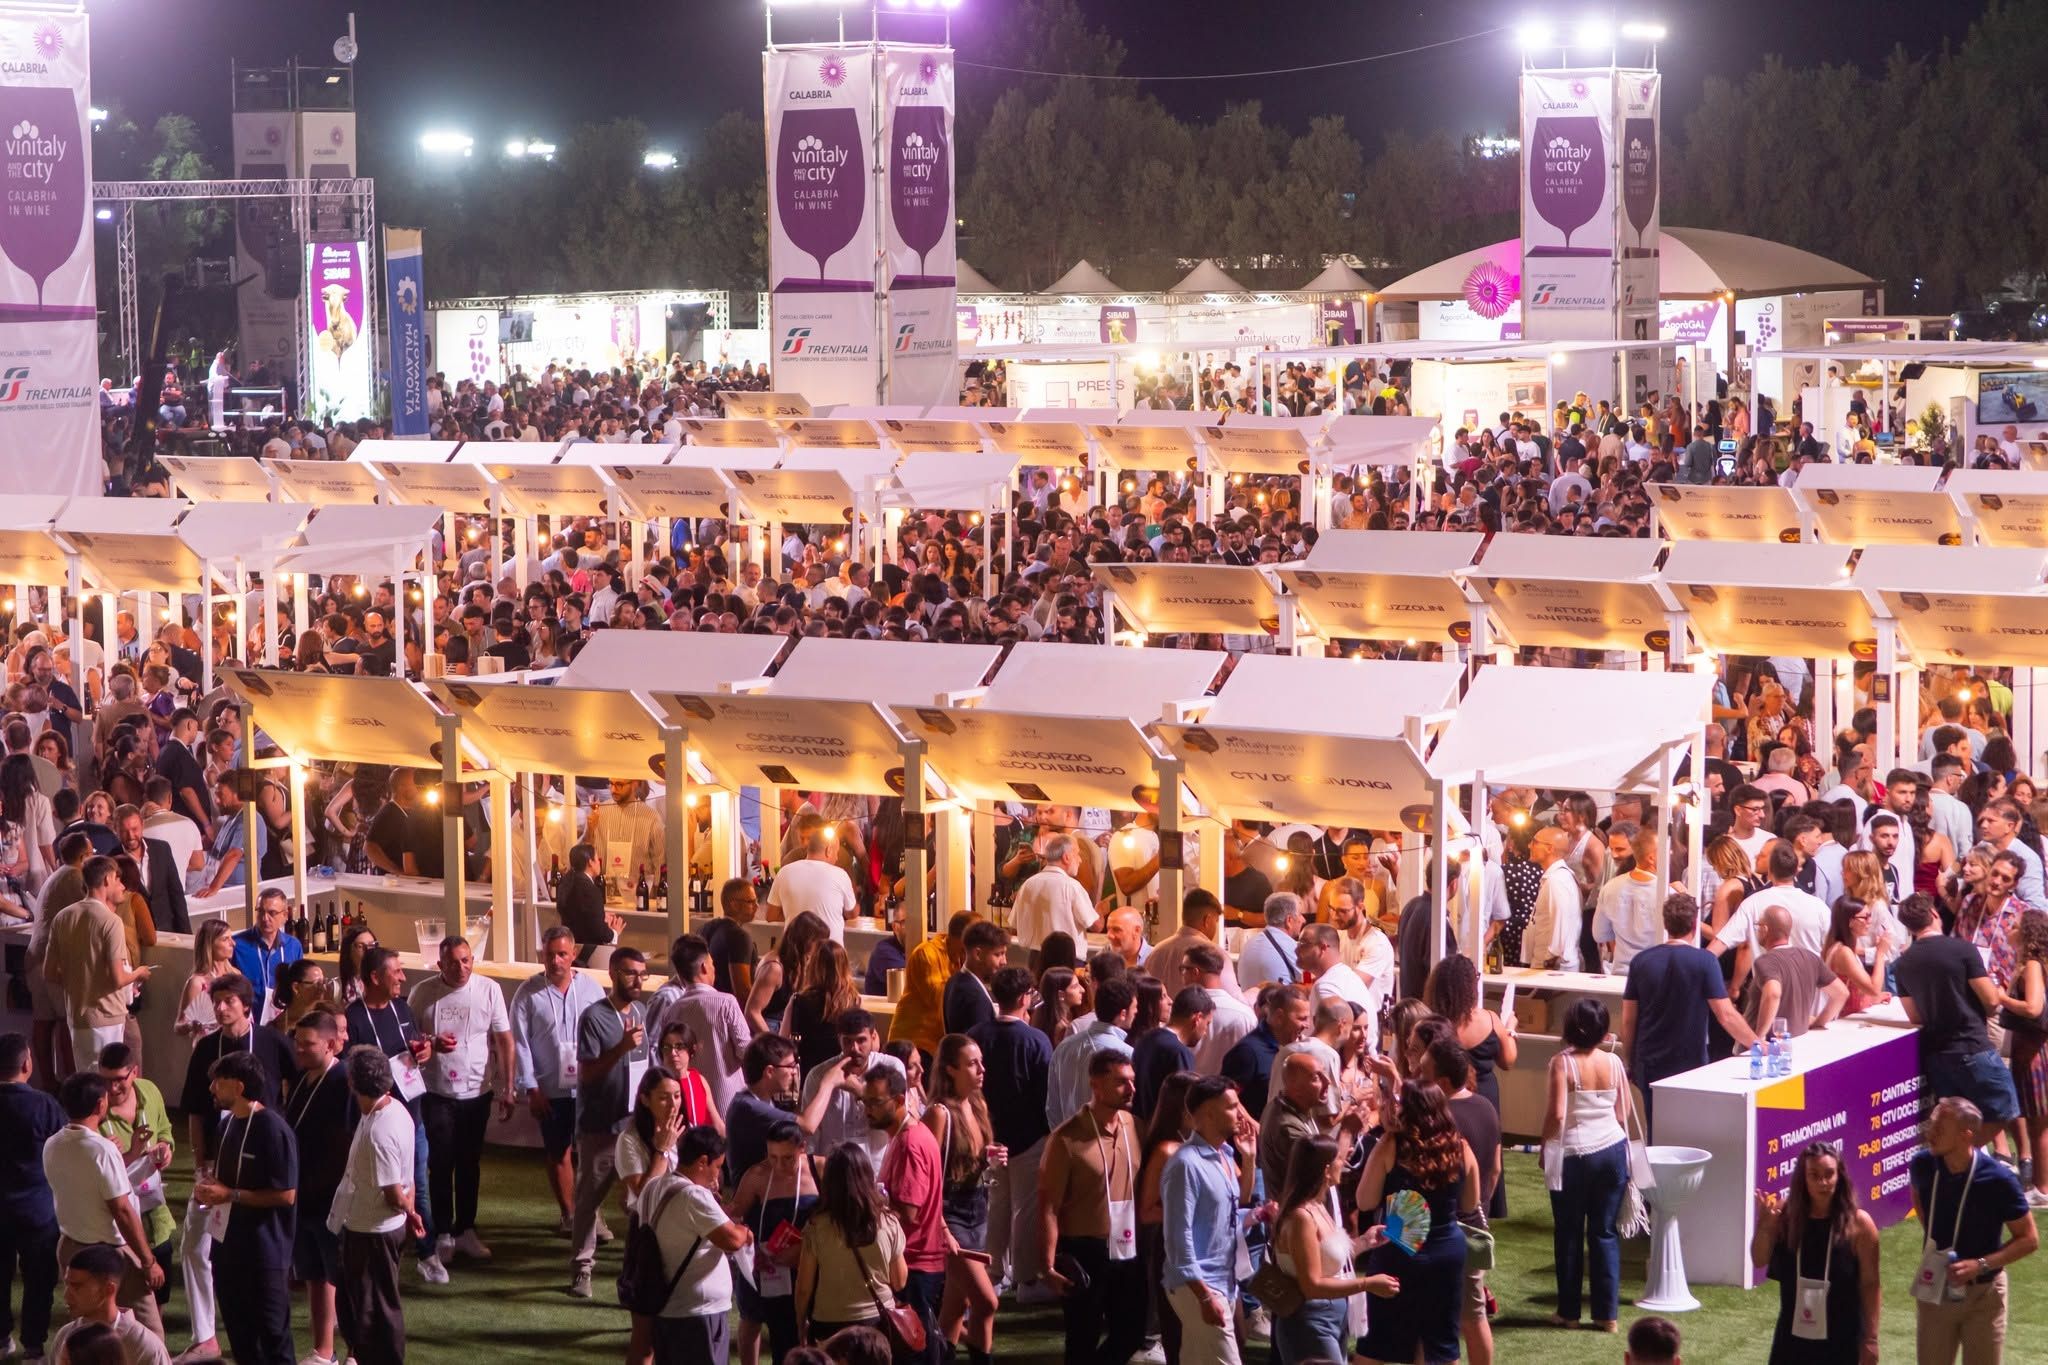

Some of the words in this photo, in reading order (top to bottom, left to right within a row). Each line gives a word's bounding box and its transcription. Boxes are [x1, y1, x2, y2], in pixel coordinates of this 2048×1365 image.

[1, 62, 48, 74] CALABRIA
[790, 90, 832, 100] CALABRIA
[901, 87, 928, 96] CALABRIA
[6, 134, 67, 162] vinitaly
[902, 142, 939, 164] vinitaly
[1545, 145, 1591, 161] vinitaly
[792, 145, 848, 166] vinitaly
[23, 159, 54, 184] city
[807, 165, 836, 184] city
[912, 162, 931, 181] city
[1557, 161, 1580, 175] city
[8, 190, 57, 201] CALABRIA
[794, 189, 839, 199] CALABRIA
[903, 186, 934, 195] CALABRIA
[795, 201, 805, 210] IN
[809, 200, 832, 210] WINE
[913, 198, 930, 206] WINE
[9, 205, 20, 215] IN
[25, 204, 51, 215] WINE
[1553, 297, 1606, 305] TRENITALIA
[1106, 311, 1130, 319] SIBARI
[1324, 310, 1348, 319] SIBARI
[913, 340, 952, 350] TRENITALIA
[1234, 332, 1271, 344] vinitaly
[1282, 334, 1301, 345] city
[807, 345, 868, 354] TRENITALIA
[404, 322, 414, 416] MALAVOLTA
[26, 387, 92, 400] TRENITALIA
[744, 407, 803, 415] CASA
[1526, 613, 1557, 621] SAN
[1786, 619, 1847, 628] GROSSO
[491, 724, 543, 735] TERRE
[747, 732, 844, 746] CONSORZIO
[736, 744, 794, 755] GRECO
[795, 746, 814, 757] DI
[1000, 750, 1092, 762] ONSORZIO
[1039, 762, 1058, 771] DI
[1060, 763, 1126, 776] BIANCO
[1231, 771, 1268, 783] CTV
[1871, 1092, 1881, 1107] 77
[1882, 1080, 1912, 1103] CANTINE
[1871, 1116, 1881, 1131] 78
[1882, 1111, 1898, 1126] CTV
[1898, 1102, 1912, 1120] DOC
[1768, 1139, 1778, 1155] 73
[1780, 1116, 1832, 1149] TRAMONTANA
[1832, 1110, 1847, 1128] VINI
[1858, 1138, 1881, 1159] 79-80
[1882, 1124, 1917, 1149] CONSORZIO
[1873, 1162, 1881, 1176] 81
[1882, 1148, 1905, 1172] TERRE
[1767, 1166, 1778, 1182] 74
[1871, 1185, 1881, 1200] 82
